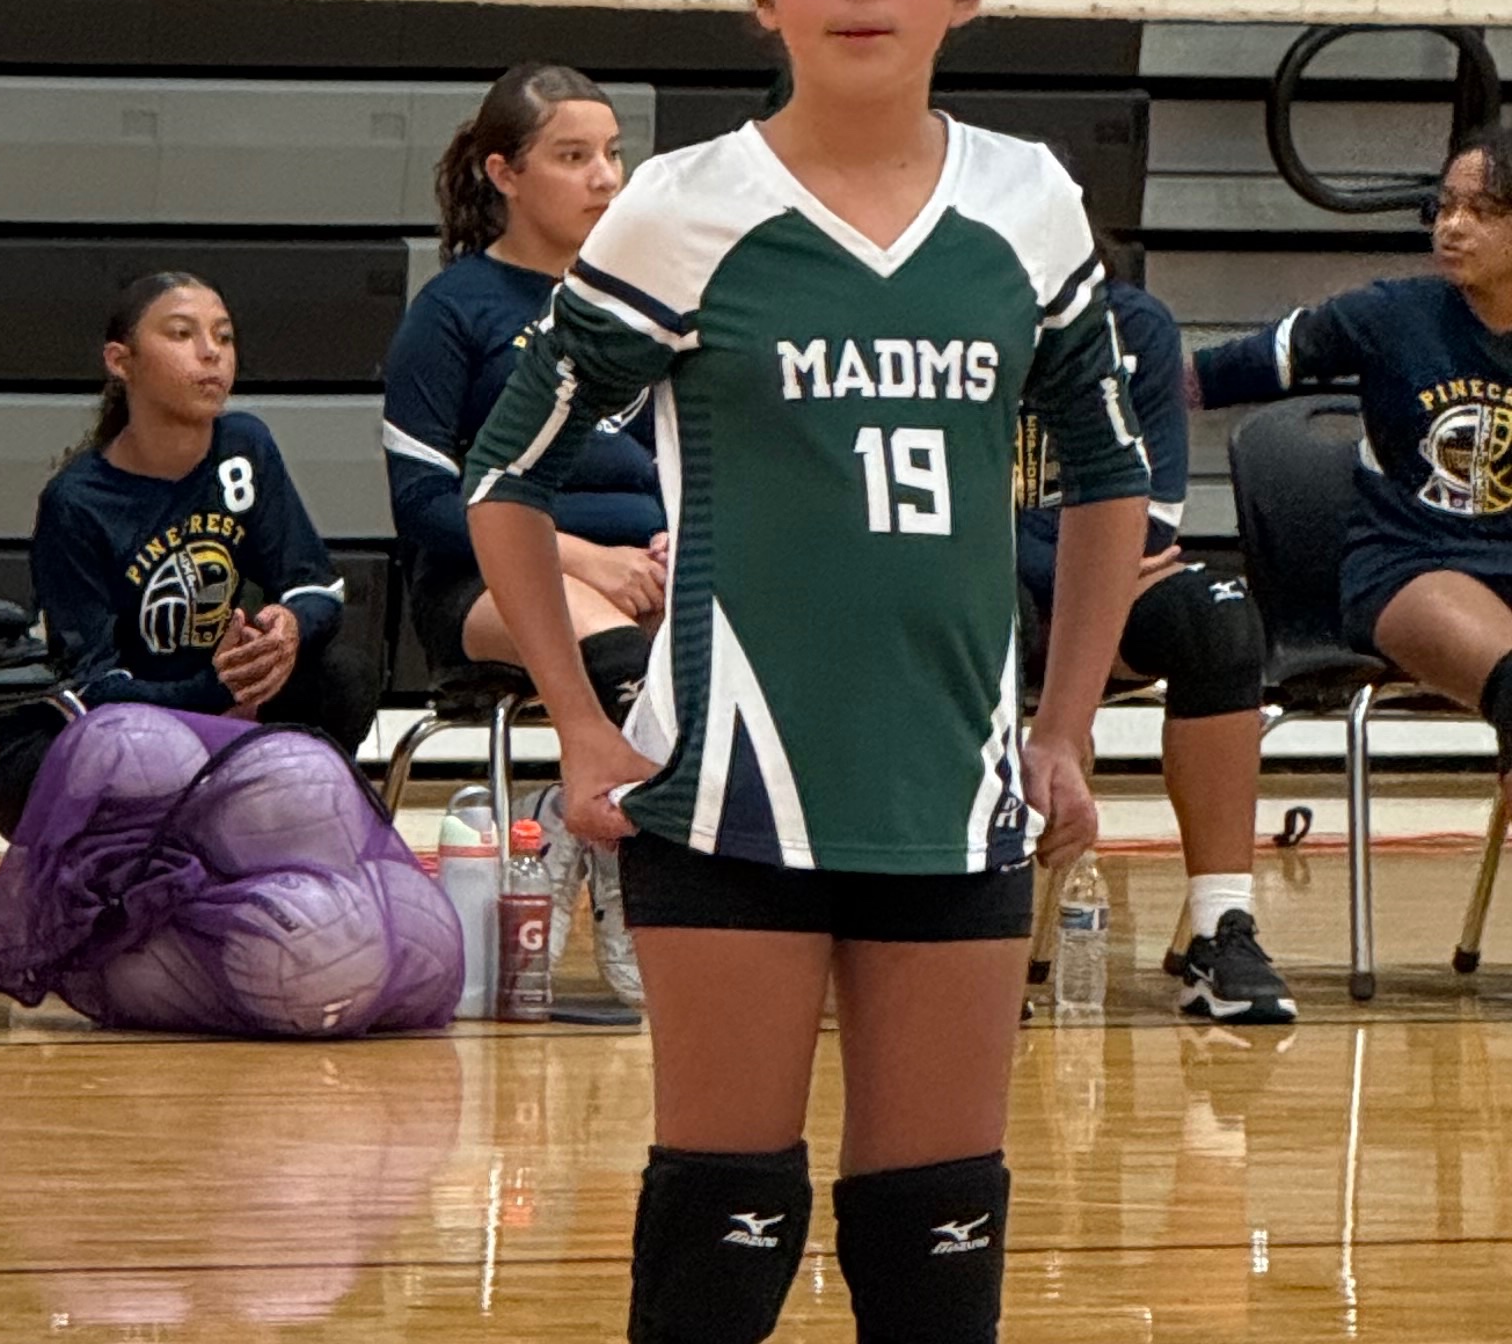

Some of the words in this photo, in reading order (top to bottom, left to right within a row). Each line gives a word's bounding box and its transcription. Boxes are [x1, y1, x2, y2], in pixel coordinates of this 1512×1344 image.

[777, 339, 999, 402] MADMS
[1418, 378, 1512, 411] PINEC
[218, 456, 255, 513] 8
[853, 427, 952, 536] 19
[125, 513, 247, 586] PINEREST
[519, 920, 544, 951] G
